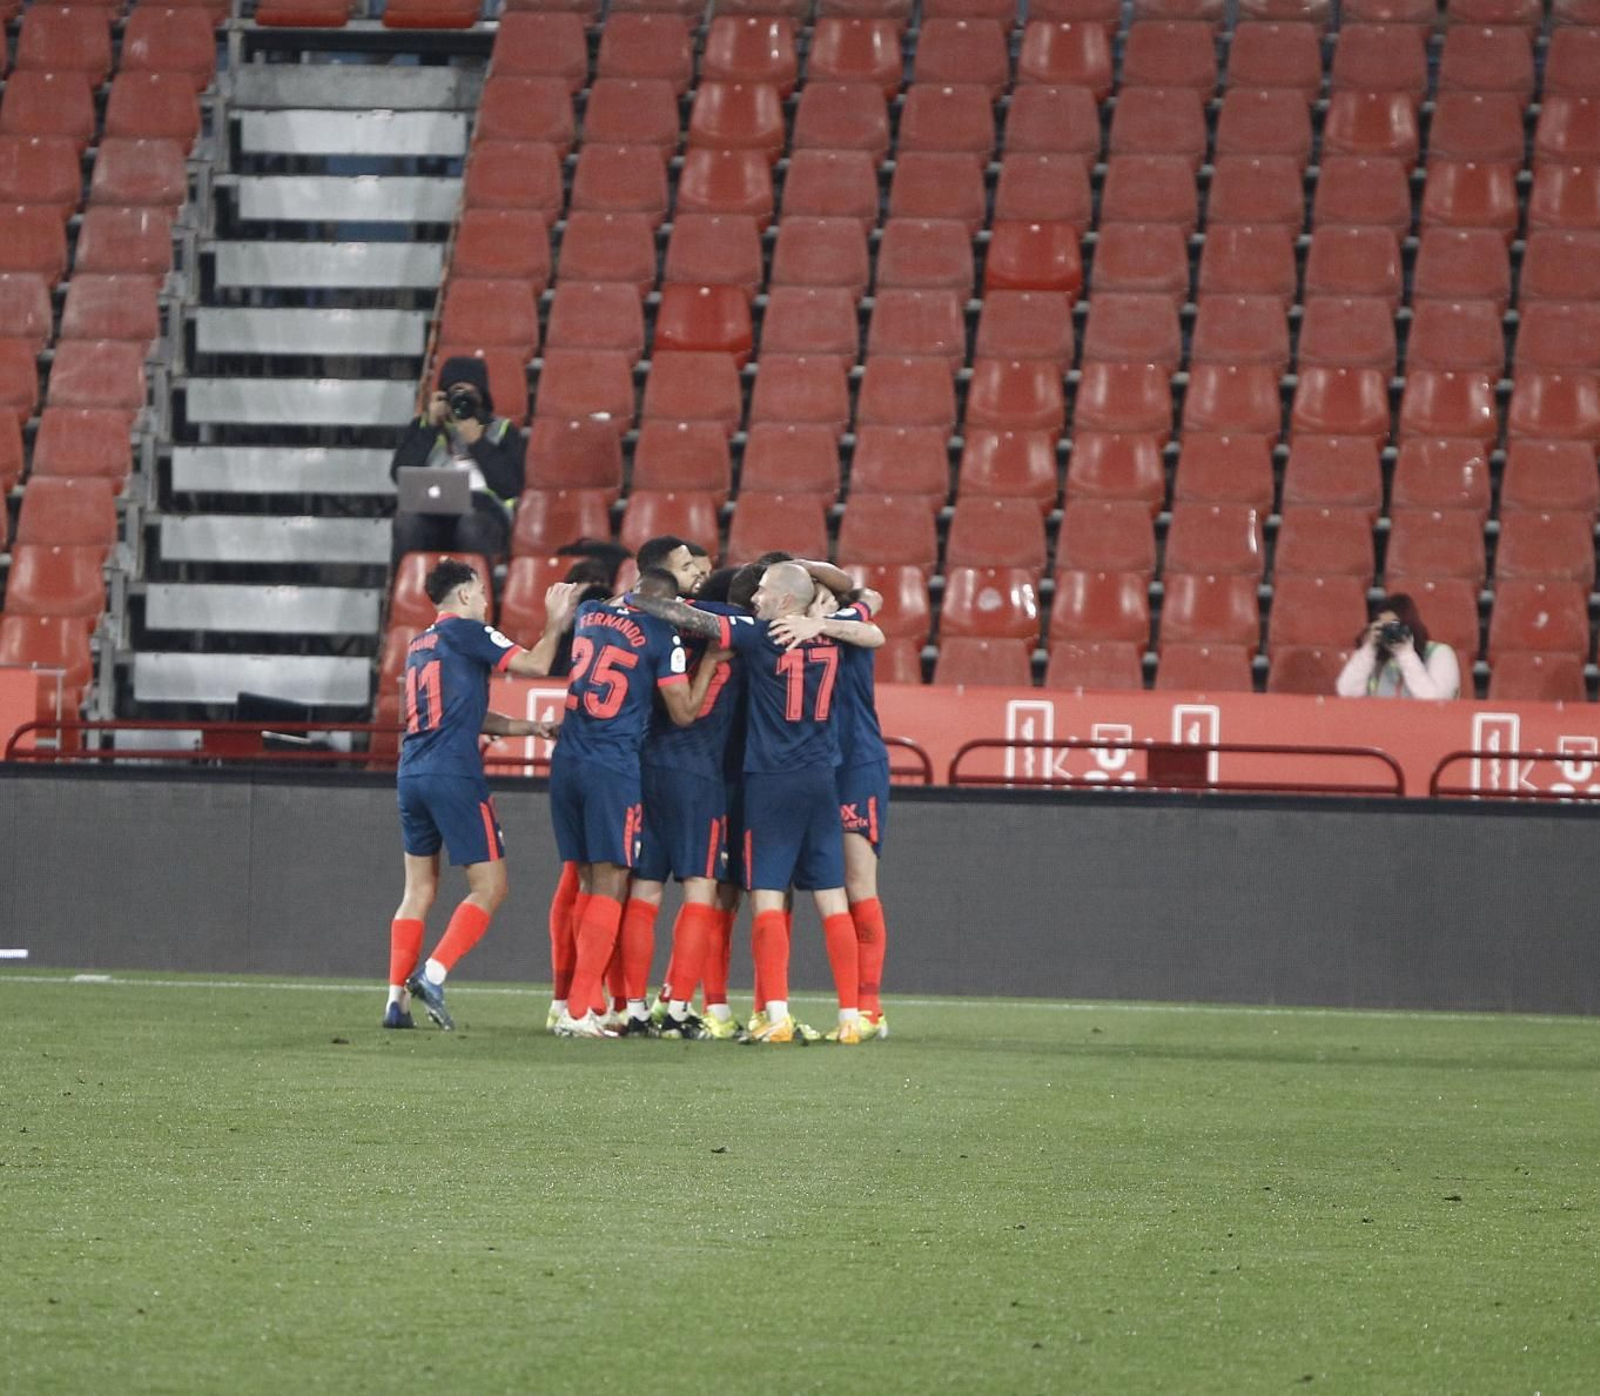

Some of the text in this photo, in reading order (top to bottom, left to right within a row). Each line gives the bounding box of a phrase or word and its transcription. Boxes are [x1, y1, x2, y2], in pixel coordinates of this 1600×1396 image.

[580, 611, 647, 649] FERNANDO
[405, 659, 442, 734] 11
[565, 635, 639, 719] 25
[776, 646, 839, 721] 17
